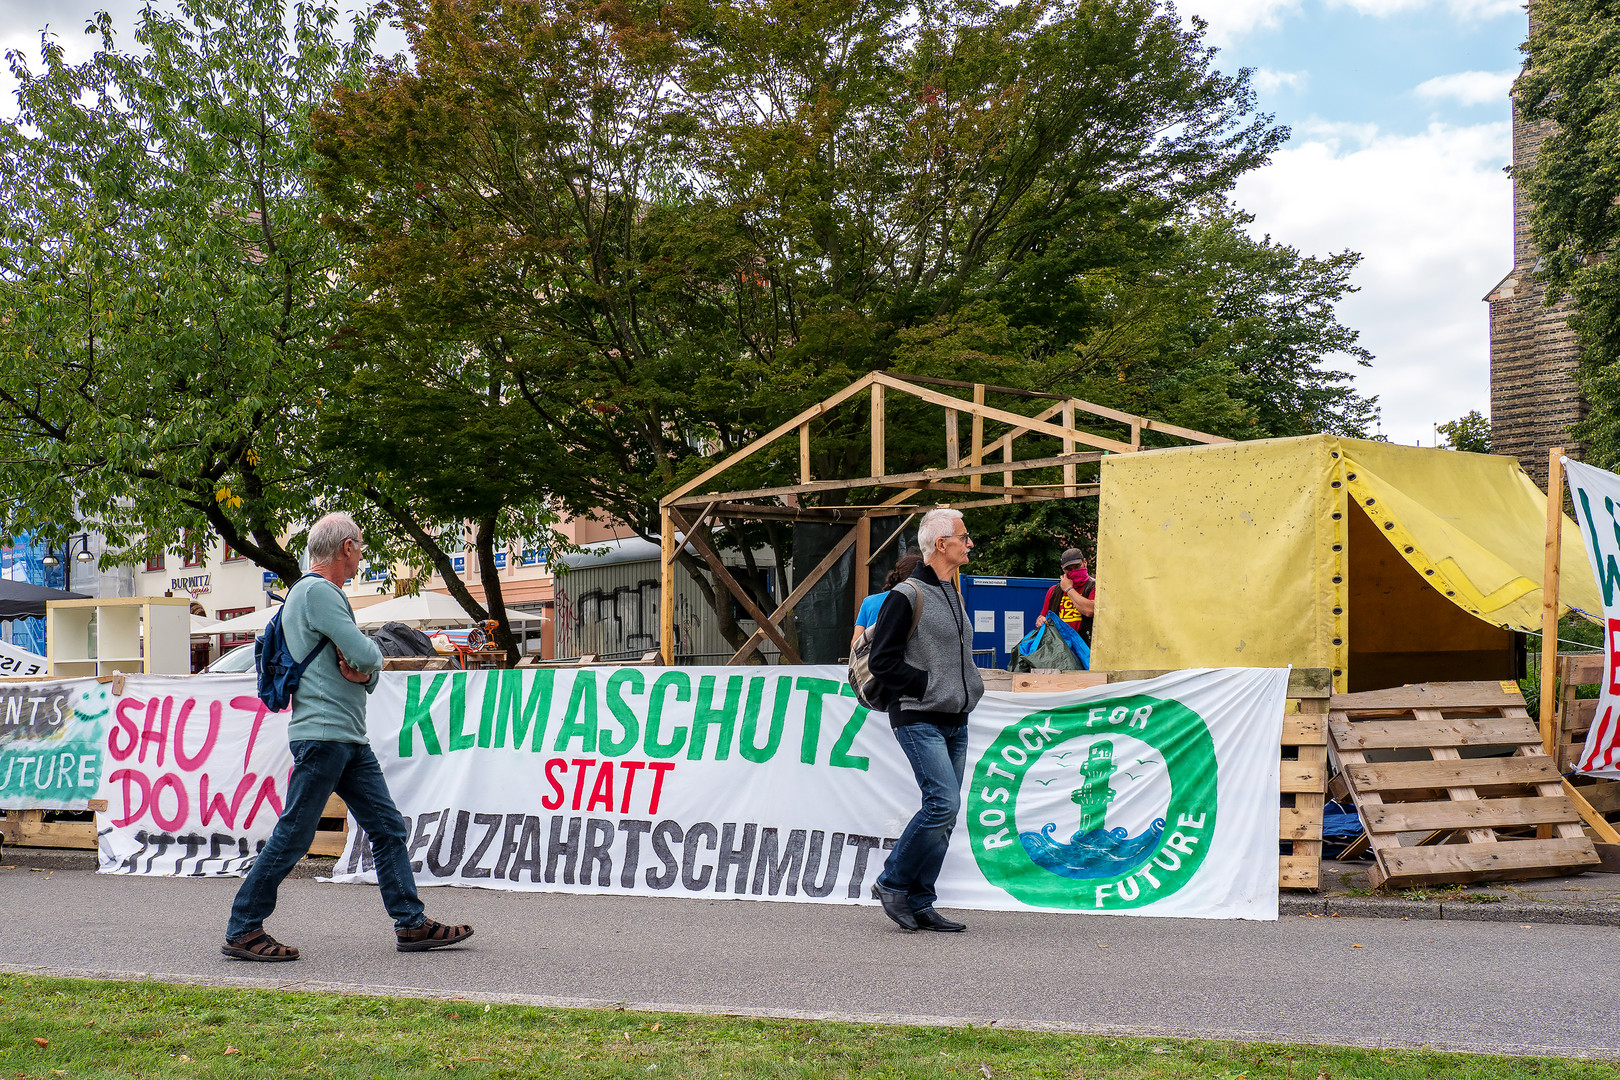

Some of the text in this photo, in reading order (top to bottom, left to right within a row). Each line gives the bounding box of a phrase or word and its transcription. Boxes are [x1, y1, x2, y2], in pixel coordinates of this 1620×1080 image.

[171, 575, 210, 592] BURWITZ
[0, 695, 64, 725] NTS
[108, 695, 293, 774] SHUT
[398, 667, 871, 772] KLIMASCHUTZ
[109, 765, 294, 832] DOWN
[541, 758, 675, 815] STATT
[980, 704, 1207, 908] ROSTOCK FOR FUTURE
